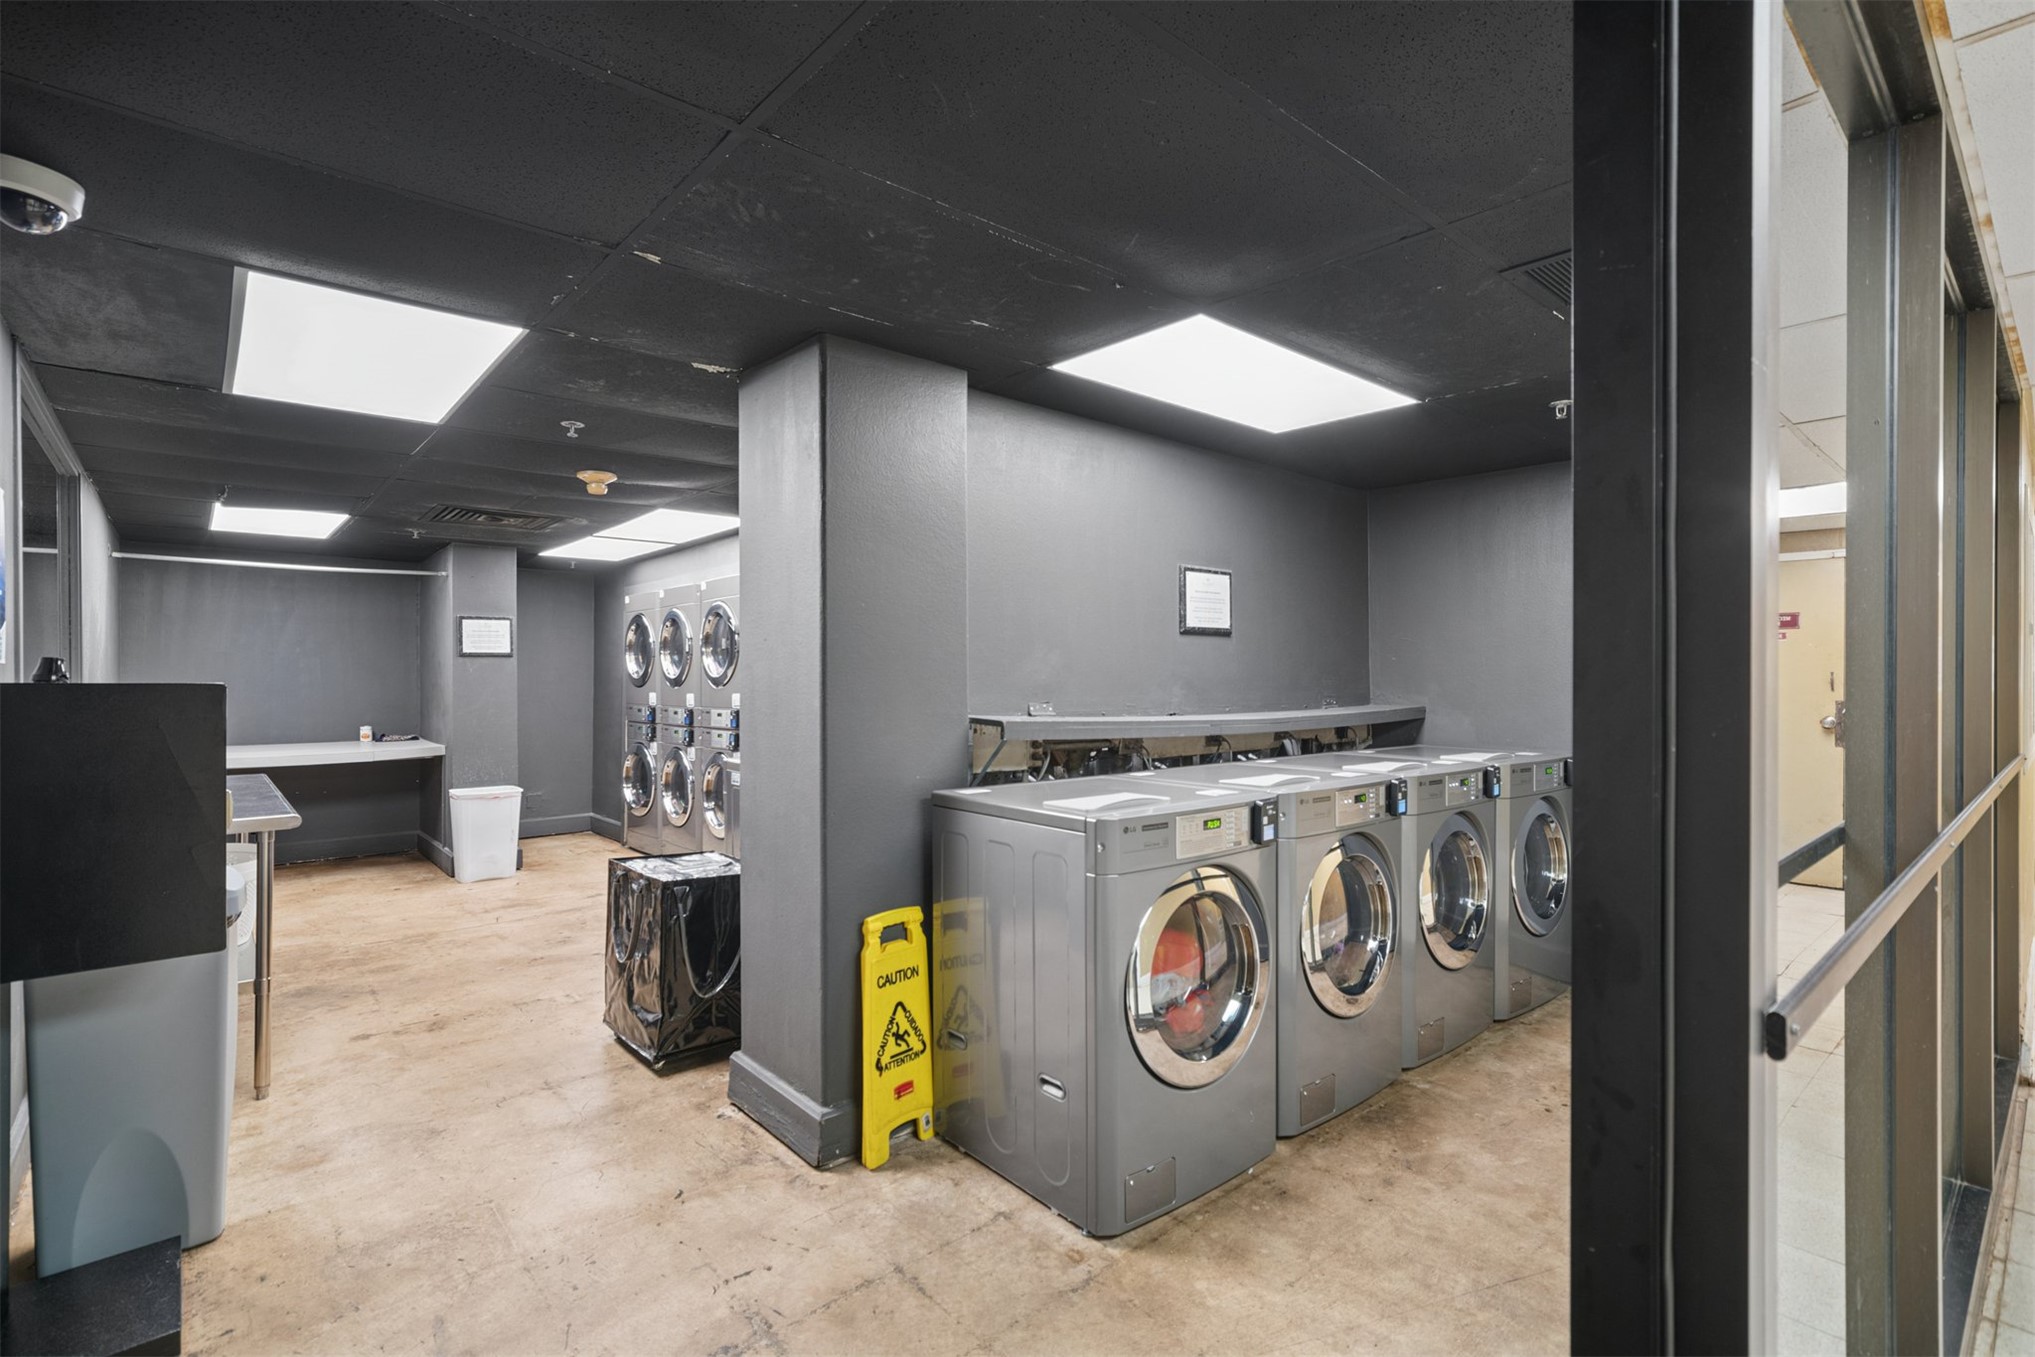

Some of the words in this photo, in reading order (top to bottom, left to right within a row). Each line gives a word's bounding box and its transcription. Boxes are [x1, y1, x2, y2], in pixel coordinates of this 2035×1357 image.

[877, 965, 919, 988] CAUTION
[877, 1015, 896, 1057] CAUTION
[904, 1009, 924, 1042] CUIDADO
[884, 1050, 920, 1072] ATTENTION
